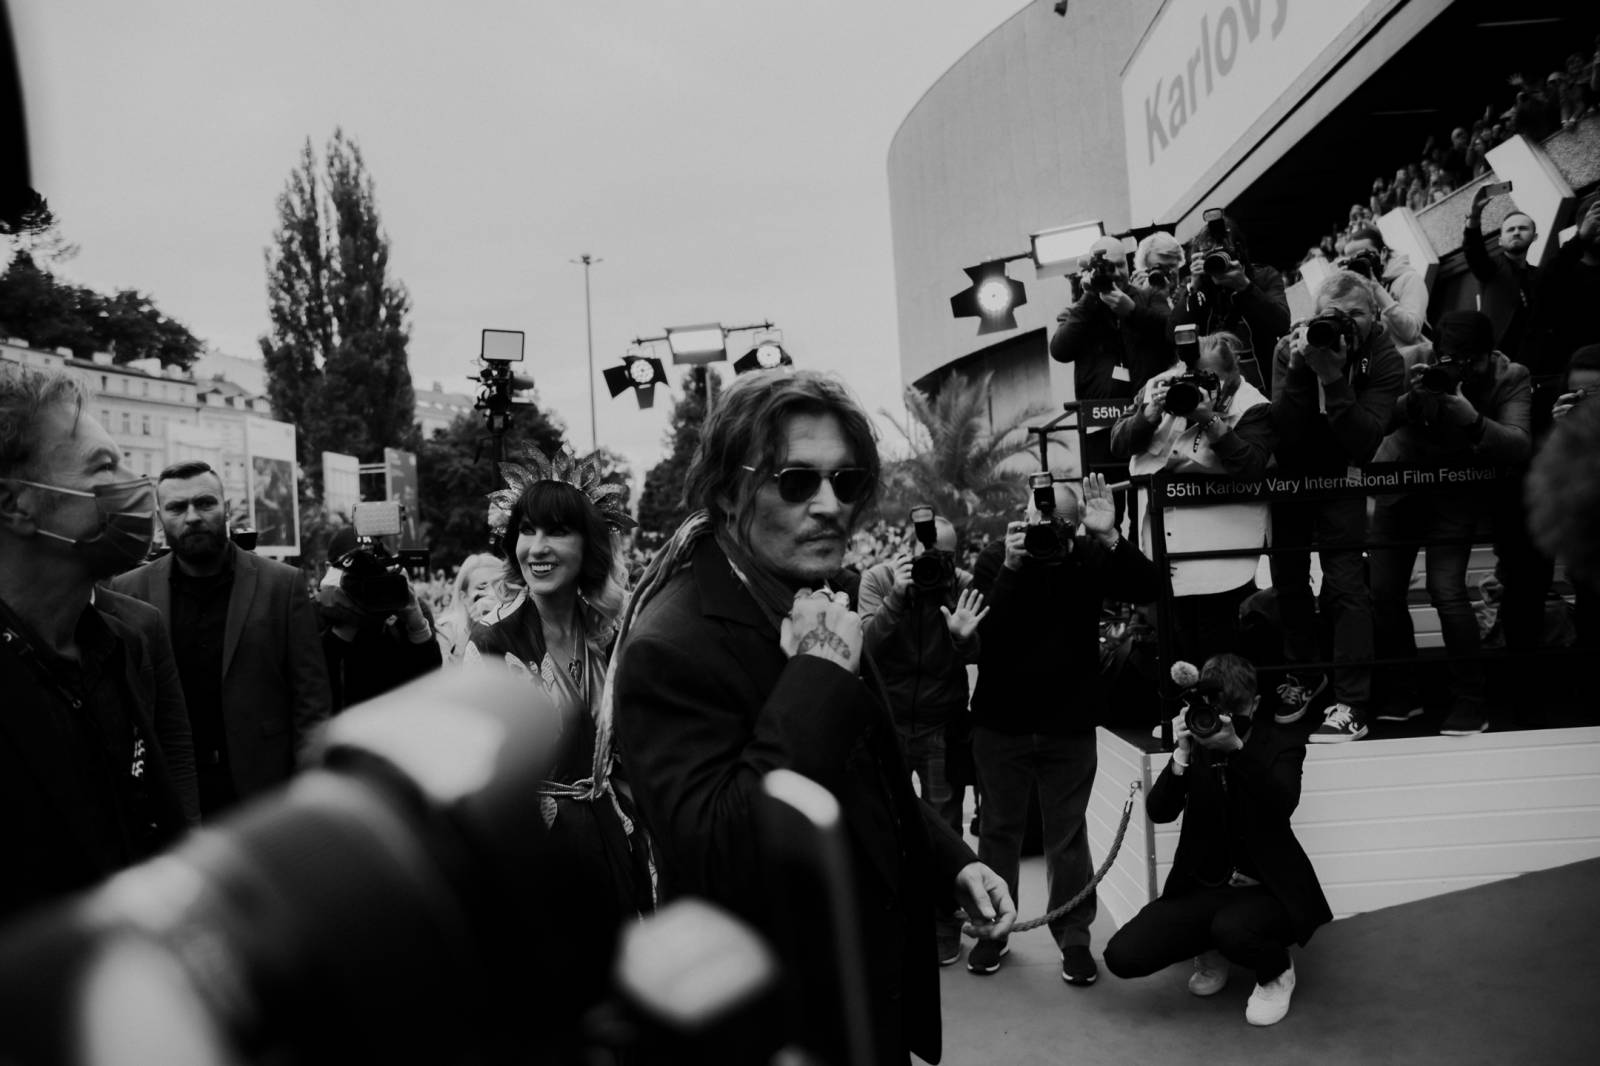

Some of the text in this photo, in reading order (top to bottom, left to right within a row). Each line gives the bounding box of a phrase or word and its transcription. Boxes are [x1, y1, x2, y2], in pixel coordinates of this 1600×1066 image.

[1092, 405, 1121, 419] 55th
[1166, 466, 1496, 497] 55th Karlovy Vary International Film Festival
